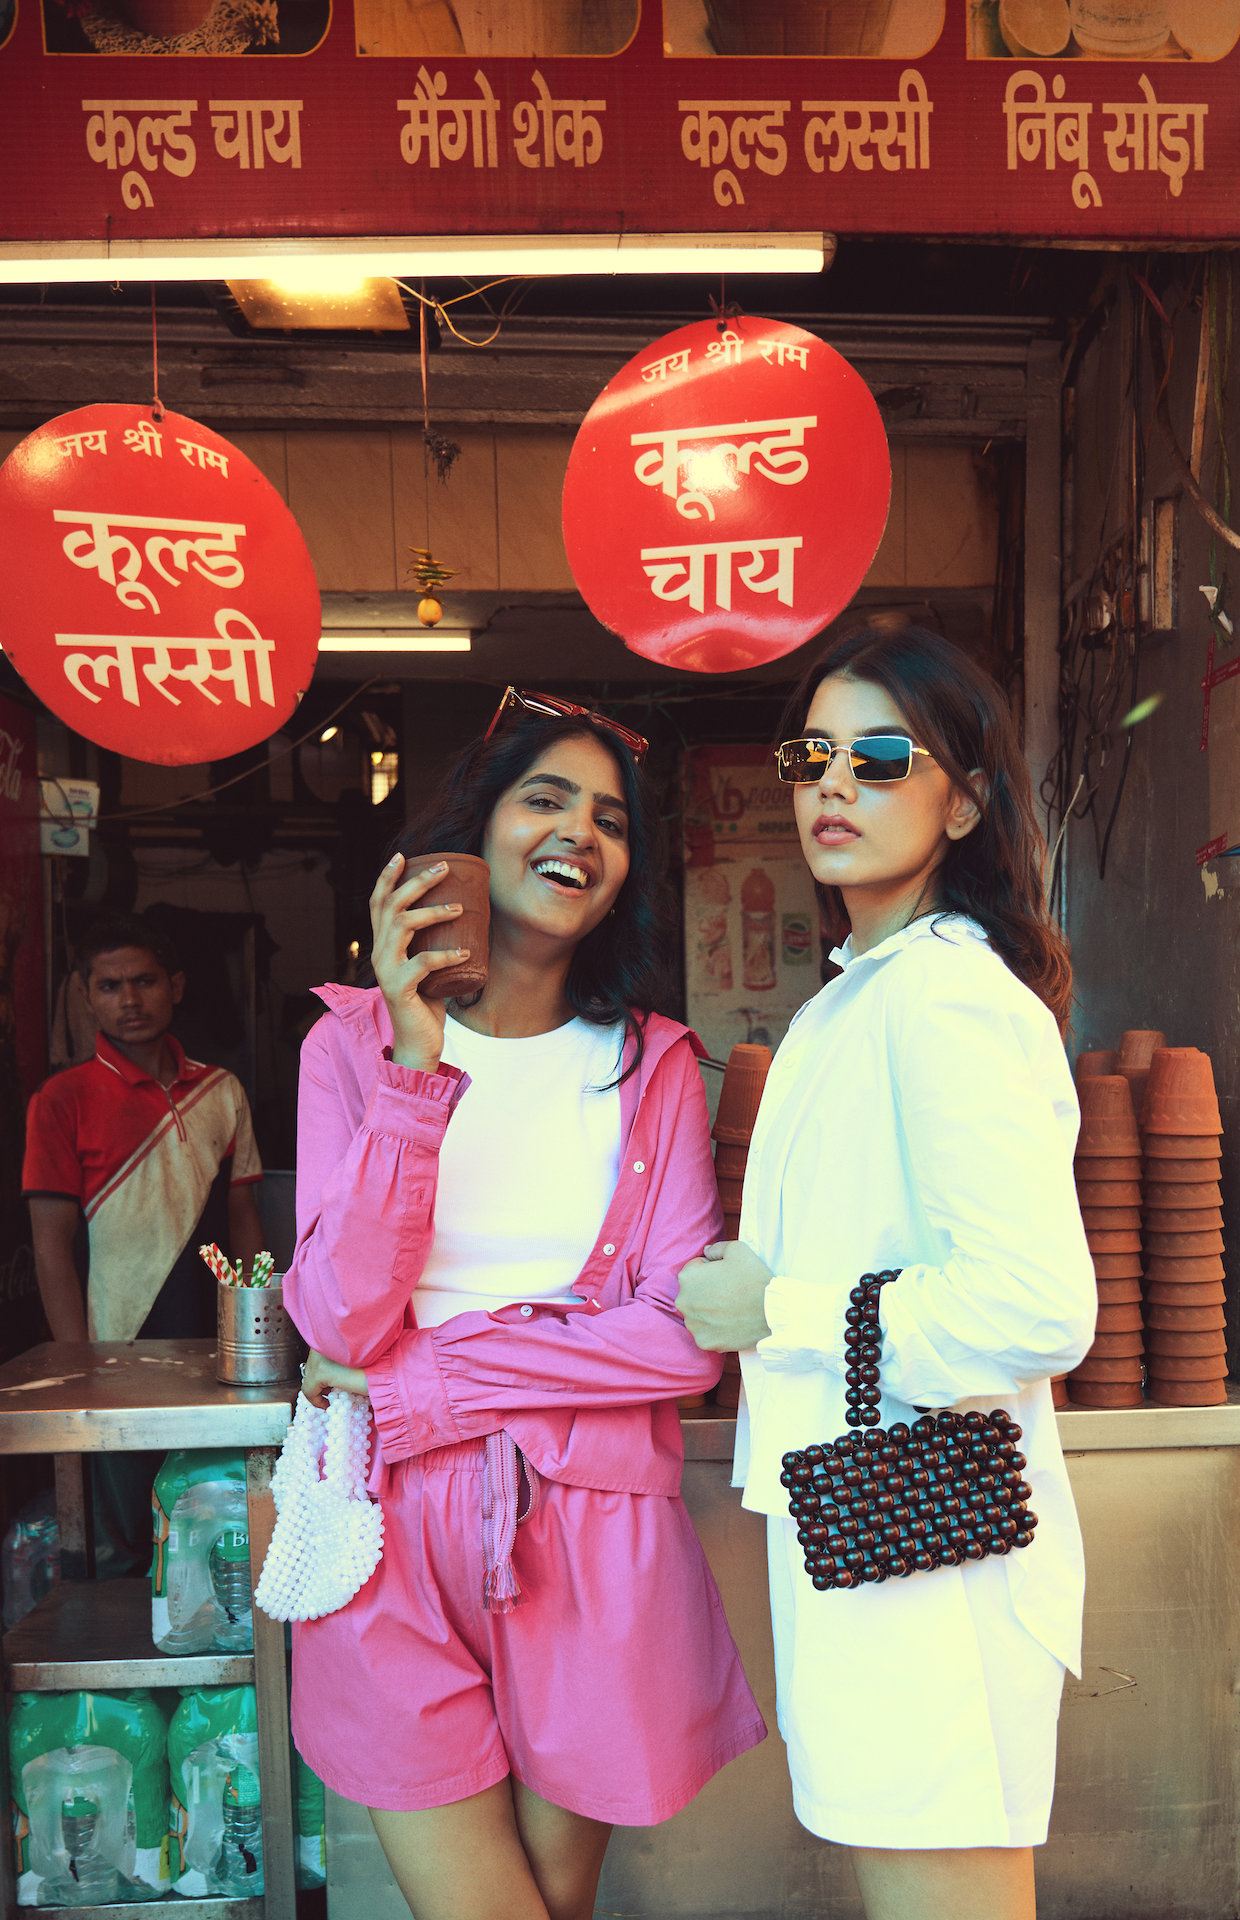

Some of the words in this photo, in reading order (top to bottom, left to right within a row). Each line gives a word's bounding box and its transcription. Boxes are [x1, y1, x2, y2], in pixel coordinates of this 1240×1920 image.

[82, 99, 198, 209] कूल्ड
[209, 99, 304, 169] चाय
[397, 65, 500, 168] मैंगो
[512, 69, 606, 168] शेक
[678, 100, 791, 206] कूल्ड
[802, 68, 933, 172] लस्सी
[1002, 69, 1102, 209] निंबू
[1102, 73, 1208, 197] सोड़ा
[641, 348, 691, 383] जय
[704, 330, 744, 365] श्री
[757, 339, 810, 371] राम
[54, 430, 107, 458] जय
[122, 420, 163, 458] श्री
[175, 438, 229, 479] राम
[630, 415, 818, 522] कूल्ड
[53, 509, 247, 614] कूल्ड
[640, 536, 803, 614] चाय
[55, 608, 276, 708] लस्सी
